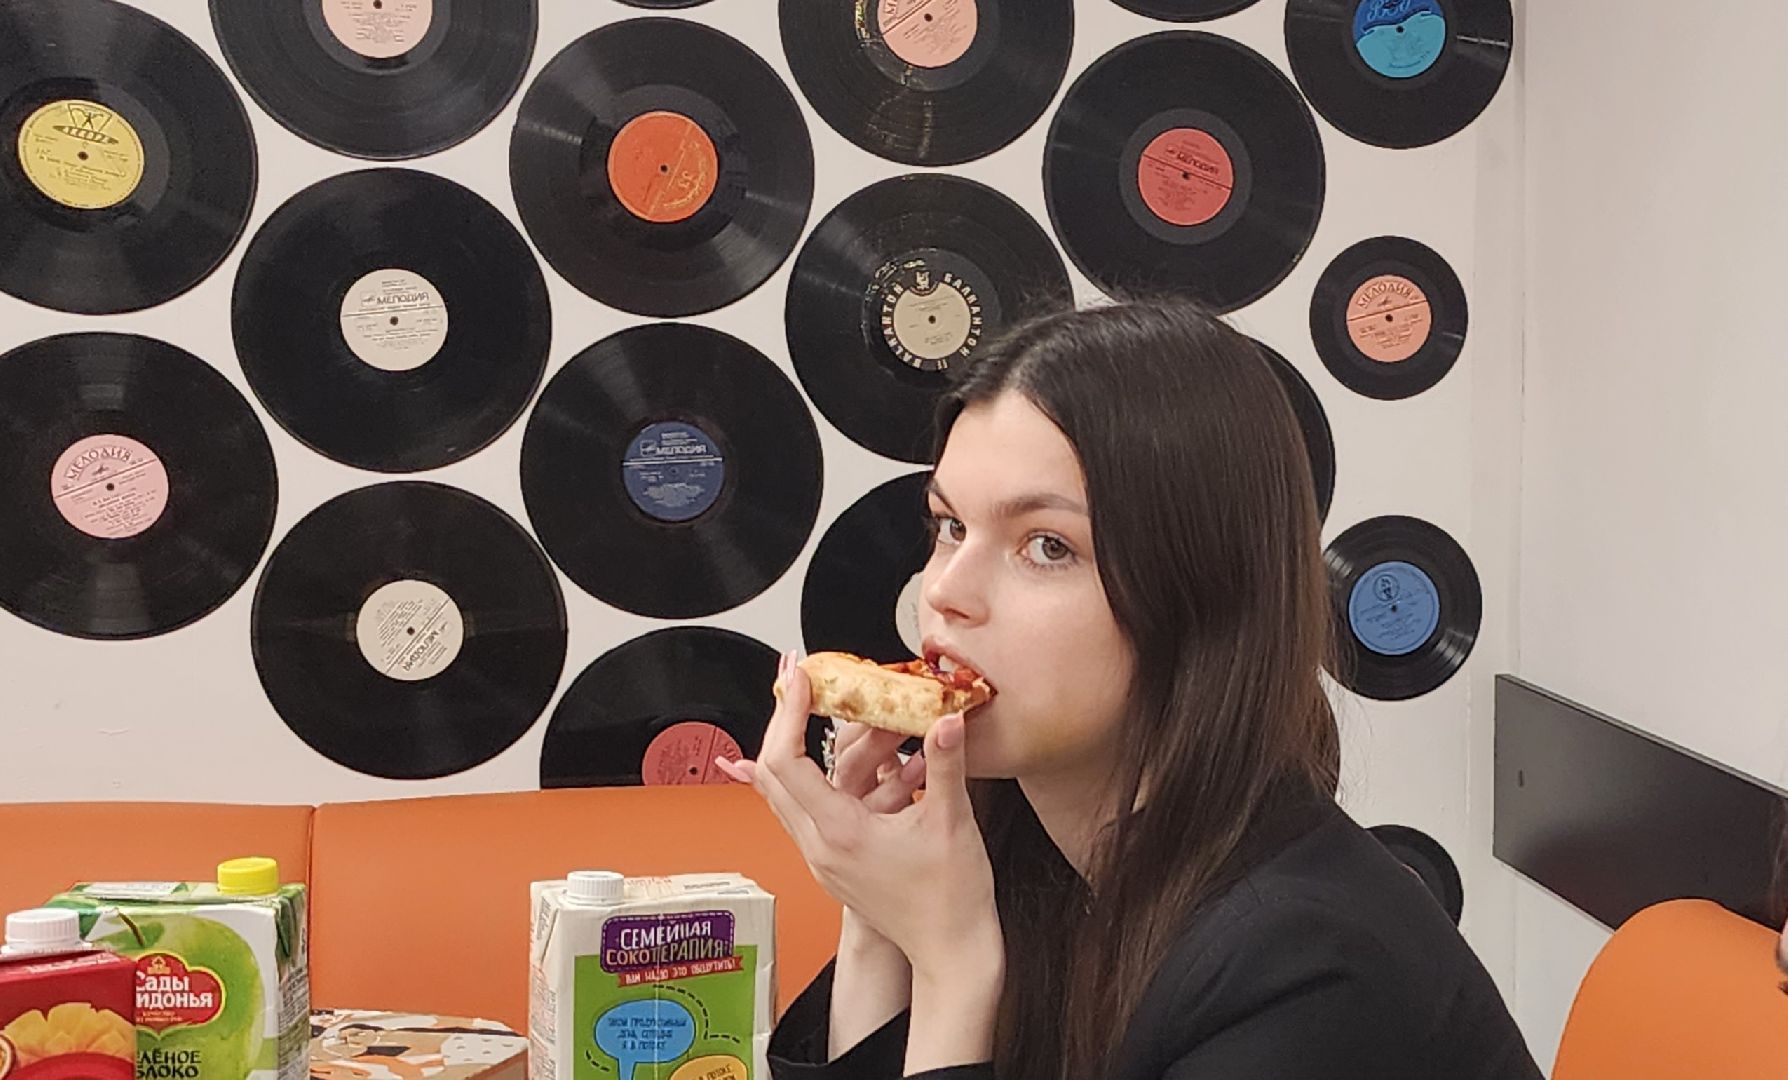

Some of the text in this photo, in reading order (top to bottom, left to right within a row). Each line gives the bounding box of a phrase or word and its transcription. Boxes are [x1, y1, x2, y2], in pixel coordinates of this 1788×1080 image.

[377, 292, 430, 304] МЕЛОДИЯ
[1356, 281, 1413, 310] МЕЛОДИЯ
[66, 447, 133, 481] МЕЛОДИЯ
[620, 920, 711, 950] СЕМЕЙНАЯ
[606, 938, 724, 966] СОКОТЕРАПИЯ
[673, 966, 688, 978] ЭТО
[136, 992, 213, 1009] идонья
[136, 1048, 202, 1064] ЛЁНОЕ
[136, 1065, 200, 1079] БЛОКО
